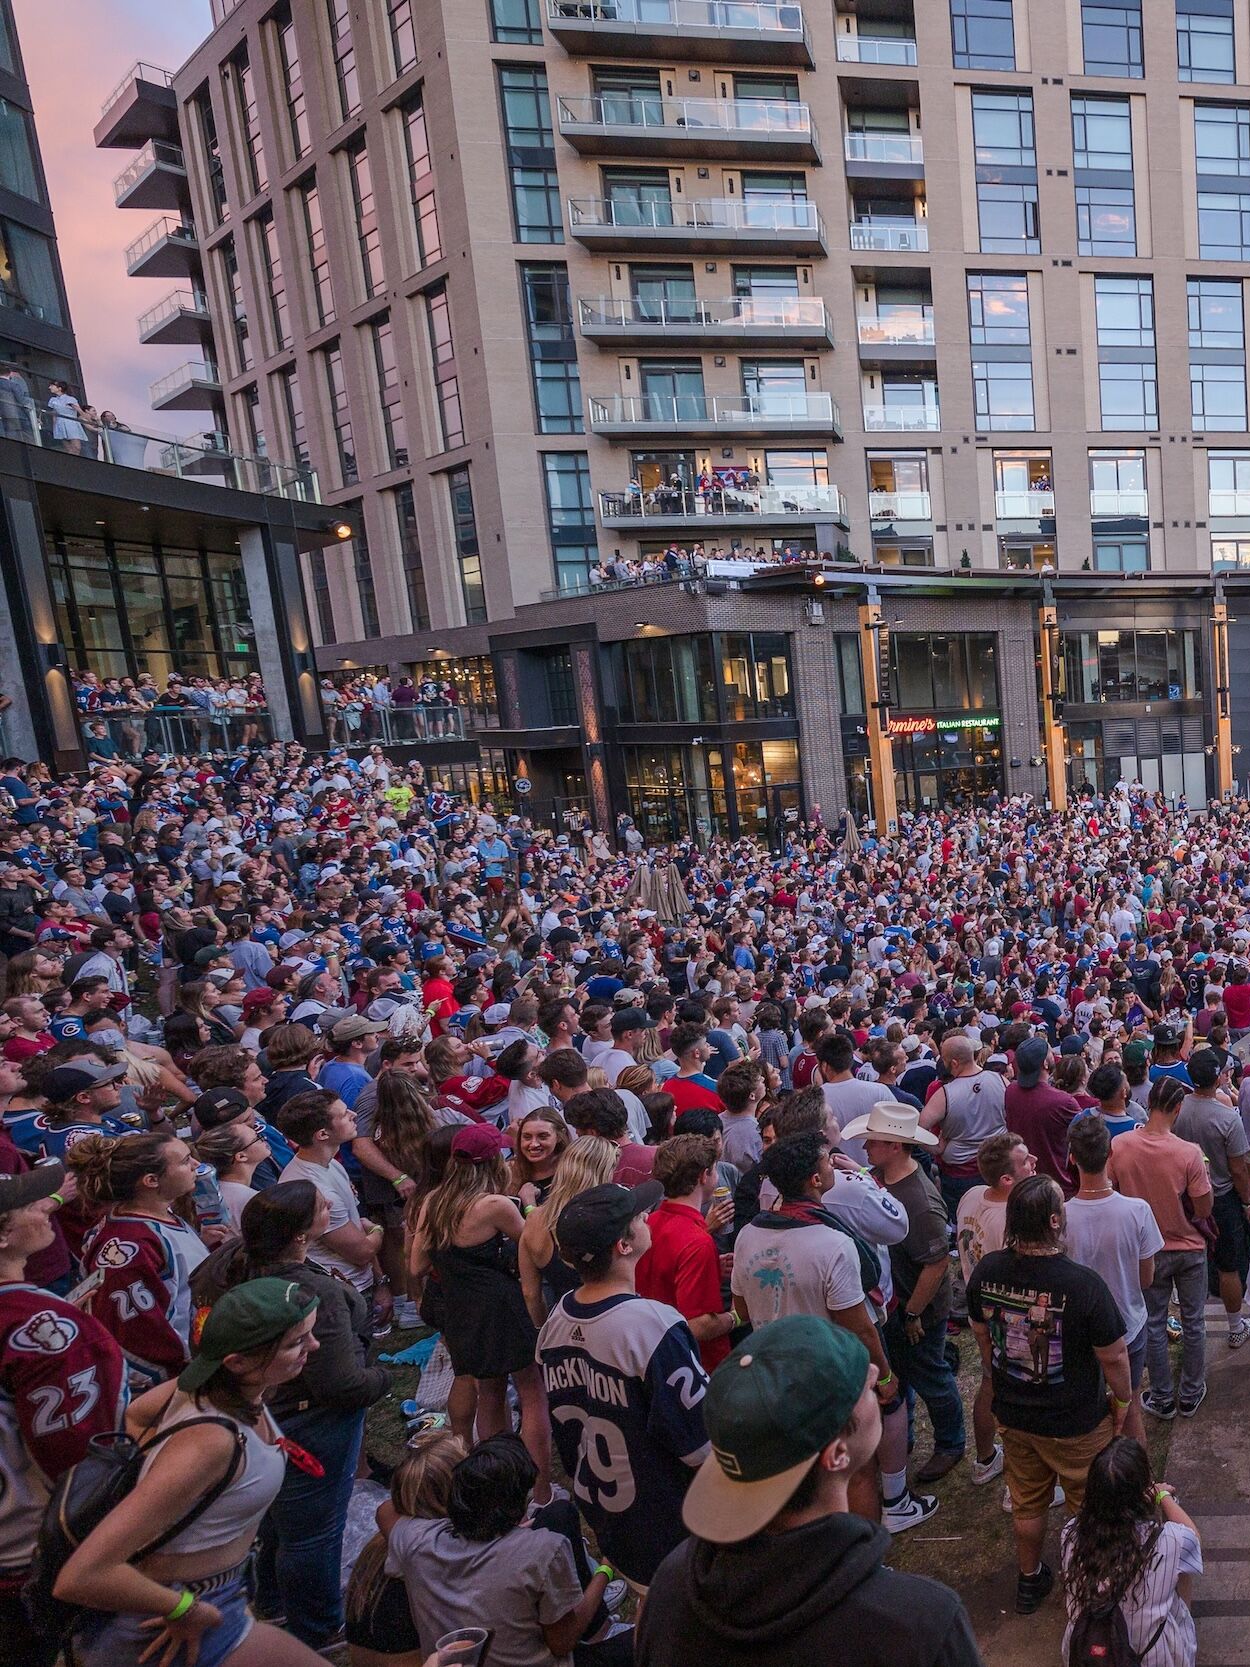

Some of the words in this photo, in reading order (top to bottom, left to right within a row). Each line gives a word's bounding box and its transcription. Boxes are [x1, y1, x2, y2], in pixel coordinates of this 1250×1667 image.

[886, 717, 936, 733] rmine's
[937, 719, 961, 729] ITALIAN
[961, 717, 1000, 728] RESTAURANT
[881, 1197, 899, 1217] 8
[109, 1280, 156, 1322] 26
[27, 1365, 99, 1438] 23
[551, 1404, 637, 1513] 29
